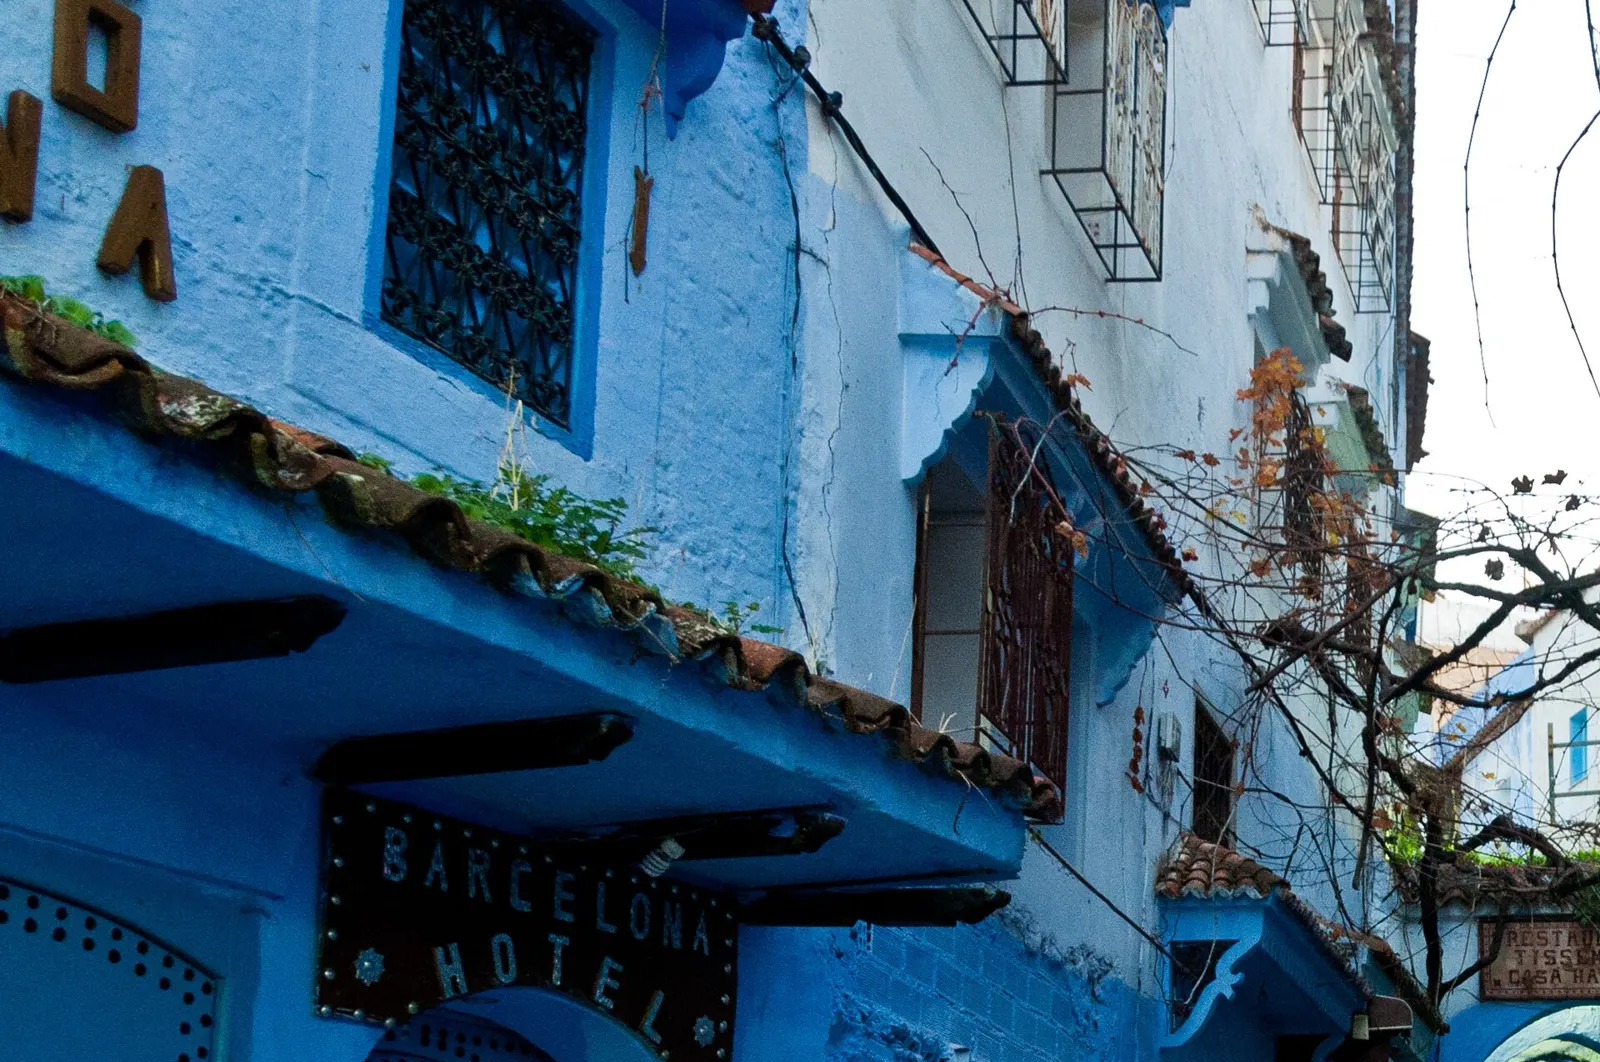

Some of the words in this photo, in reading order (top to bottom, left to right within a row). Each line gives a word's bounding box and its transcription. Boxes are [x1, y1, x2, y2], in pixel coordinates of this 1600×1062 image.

[383, 826, 709, 956] BARCELONA
[434, 933, 662, 1044] HOTEL
[1508, 968, 1562, 985] CASA
